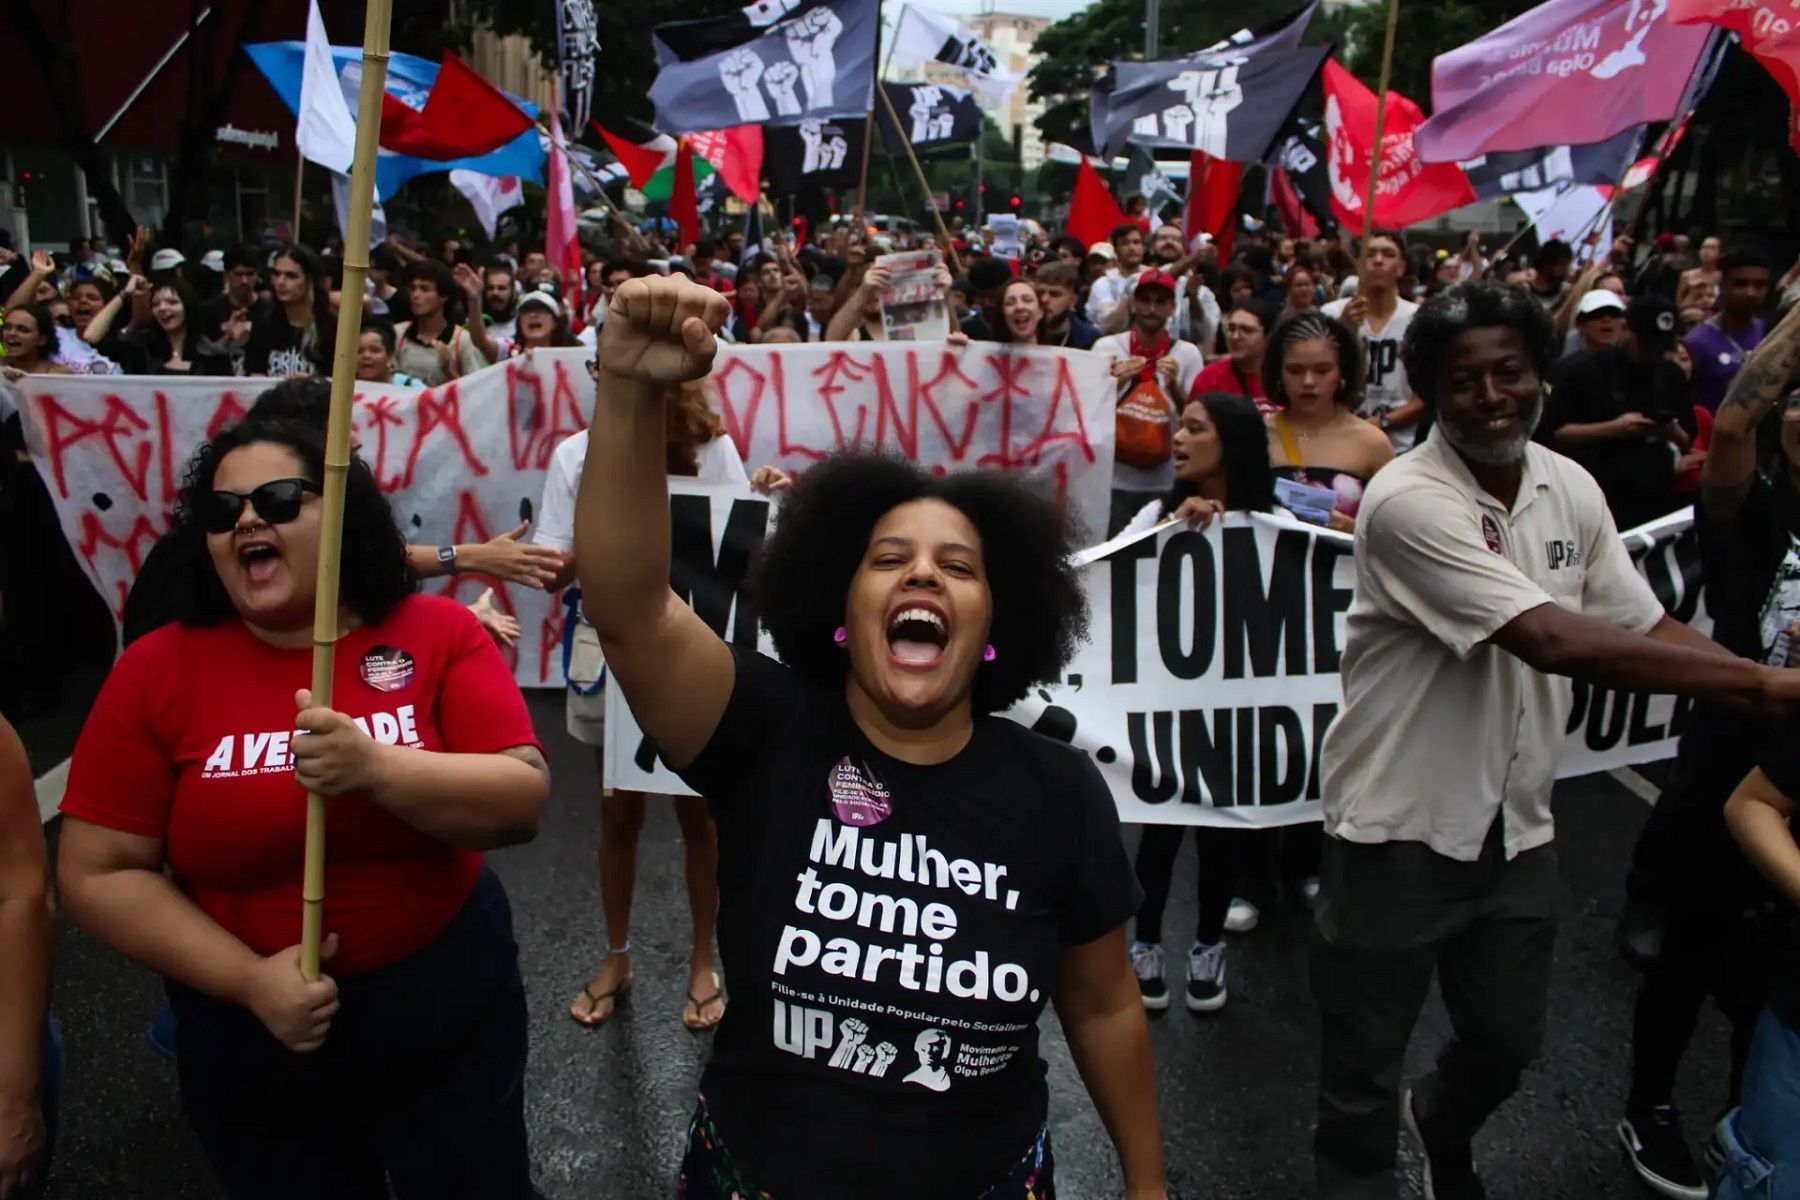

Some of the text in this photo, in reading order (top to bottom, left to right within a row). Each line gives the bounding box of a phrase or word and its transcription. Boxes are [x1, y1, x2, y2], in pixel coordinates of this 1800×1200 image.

[1545, 540, 1565, 570] UP
[1092, 526, 1355, 685] TOME
[204, 735, 234, 771] A
[211, 770, 240, 779] JORNAL
[241, 768, 258, 776] DOS
[259, 764, 296, 774] TRABALH
[809, 818, 1020, 910] Mulher,
[794, 866, 958, 940] tome
[773, 924, 1040, 1003] partido.
[771, 981, 815, 1001] Filie-se
[817, 993, 825, 1003] à
[828, 995, 885, 1013] Unidade
[886, 1005, 940, 1023] Popular
[941, 1017, 971, 1029] pelo
[773, 998, 834, 1059] UP
[953, 1064, 978, 1078] Olga
